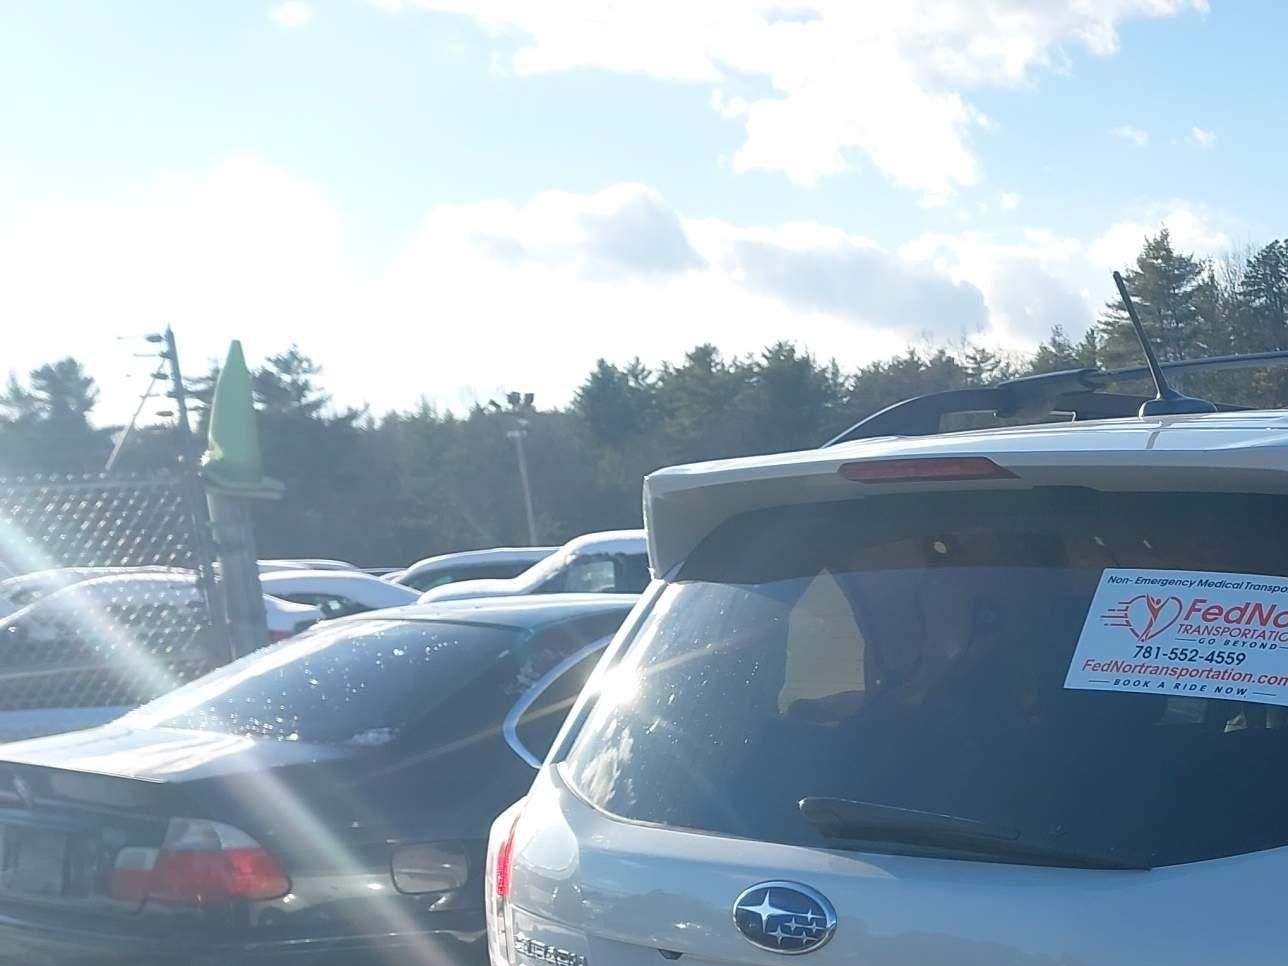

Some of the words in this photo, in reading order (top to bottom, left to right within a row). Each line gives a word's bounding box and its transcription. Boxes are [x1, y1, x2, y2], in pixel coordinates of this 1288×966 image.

[1107, 575, 1133, 585] Non-
[1134, 576, 1196, 589] Emergency
[1197, 579, 1243, 590] Medical
[1223, 640, 1279, 650] BEYOND
[1132, 646, 1246, 665] 781-552-4559
[1113, 679, 1150, 688] BOOK
[1172, 683, 1207, 692] RIDE
